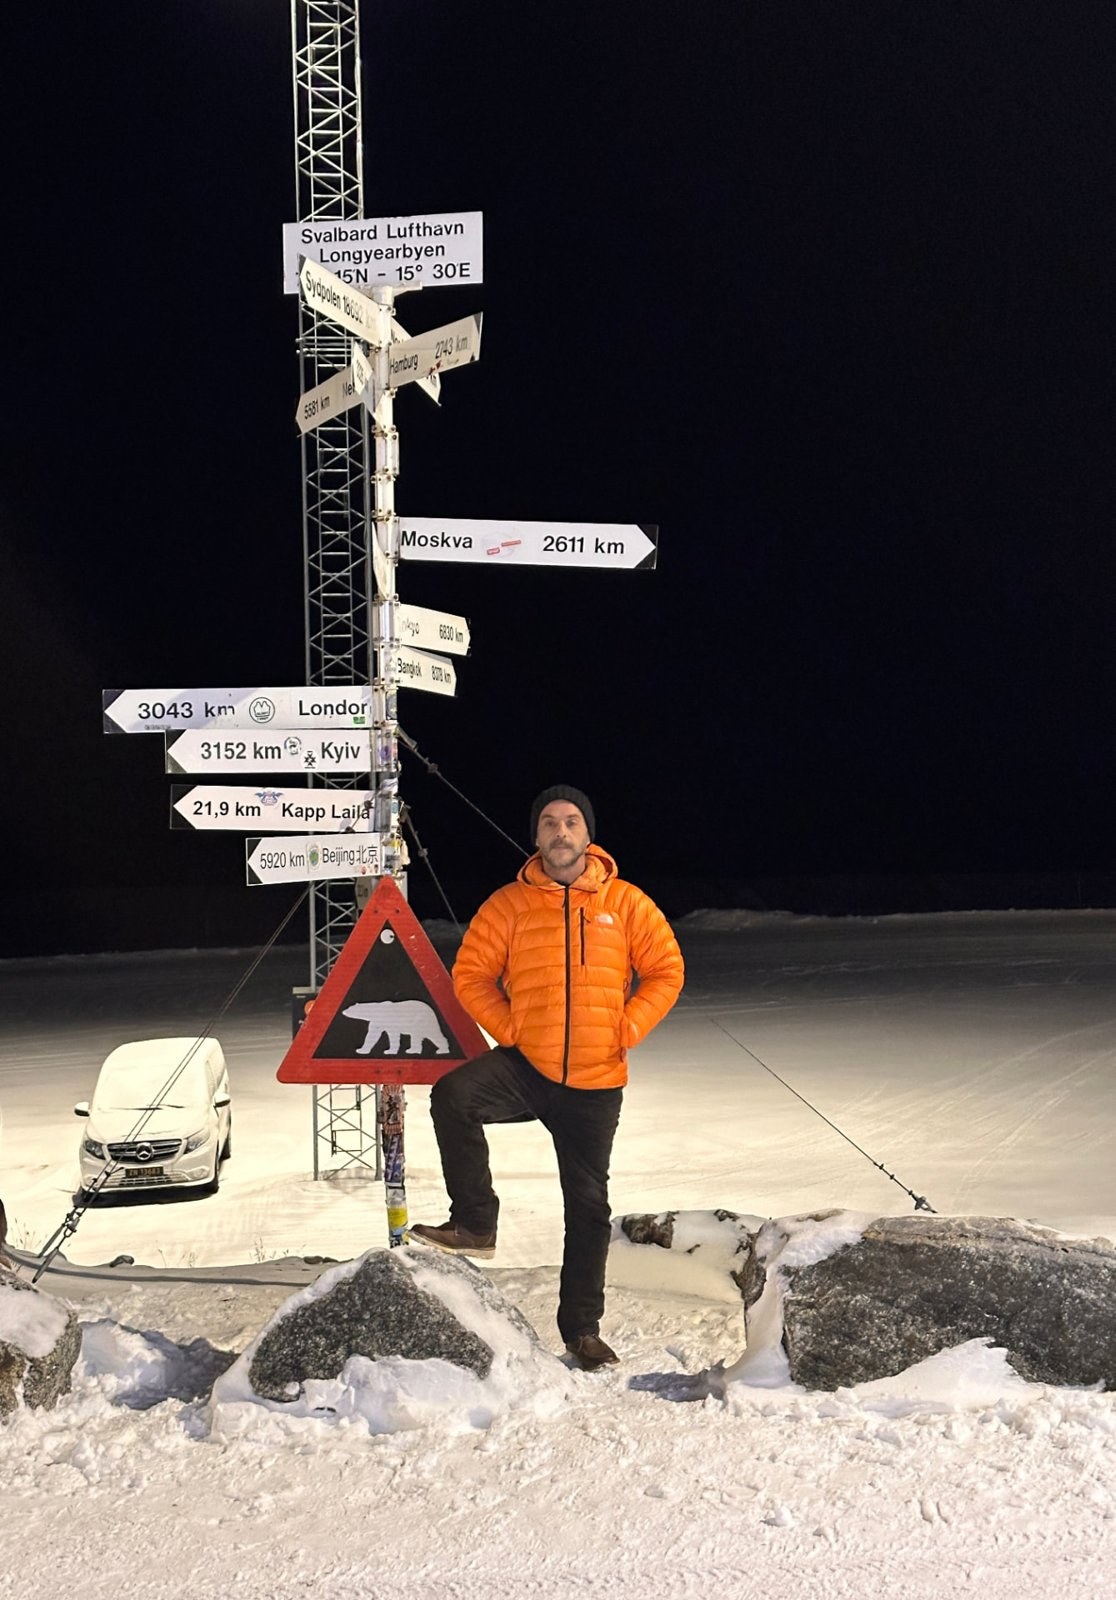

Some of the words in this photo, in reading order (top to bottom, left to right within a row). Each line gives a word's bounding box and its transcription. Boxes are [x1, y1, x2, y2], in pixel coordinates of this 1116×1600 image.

[301, 225, 377, 244] Svalbard
[387, 222, 464, 239] Lufthavn
[319, 244, 446, 265] Longyearbyen
[305, 270, 341, 310] Sydpolen
[389, 353, 419, 374] Hamburg
[434, 337, 454, 359] 2743
[455, 334, 469, 353] km
[303, 399, 320, 420] 5581
[320, 395, 331, 410] km
[401, 530, 474, 549] Moskva
[542, 535, 585, 554] 2611
[594, 537, 625, 554] km
[439, 623, 455, 641] 6830
[455, 627, 464, 643] km
[397, 657, 422, 679] Bangkok
[137, 701, 194, 720] 3043
[203, 701, 236, 718] km
[200, 741, 247, 760] 3152
[252, 741, 282, 760] km
[321, 741, 361, 764] Kyiv
[192, 800, 230, 819] 21,9
[234, 801, 262, 817] km
[281, 802, 326, 819] Kapp
[330, 803, 371, 820] Laila
[259, 851, 287, 870] 5920
[289, 849, 305, 868] km
[322, 847, 356, 866] Beijing
[355, 844, 379, 865] 北京
